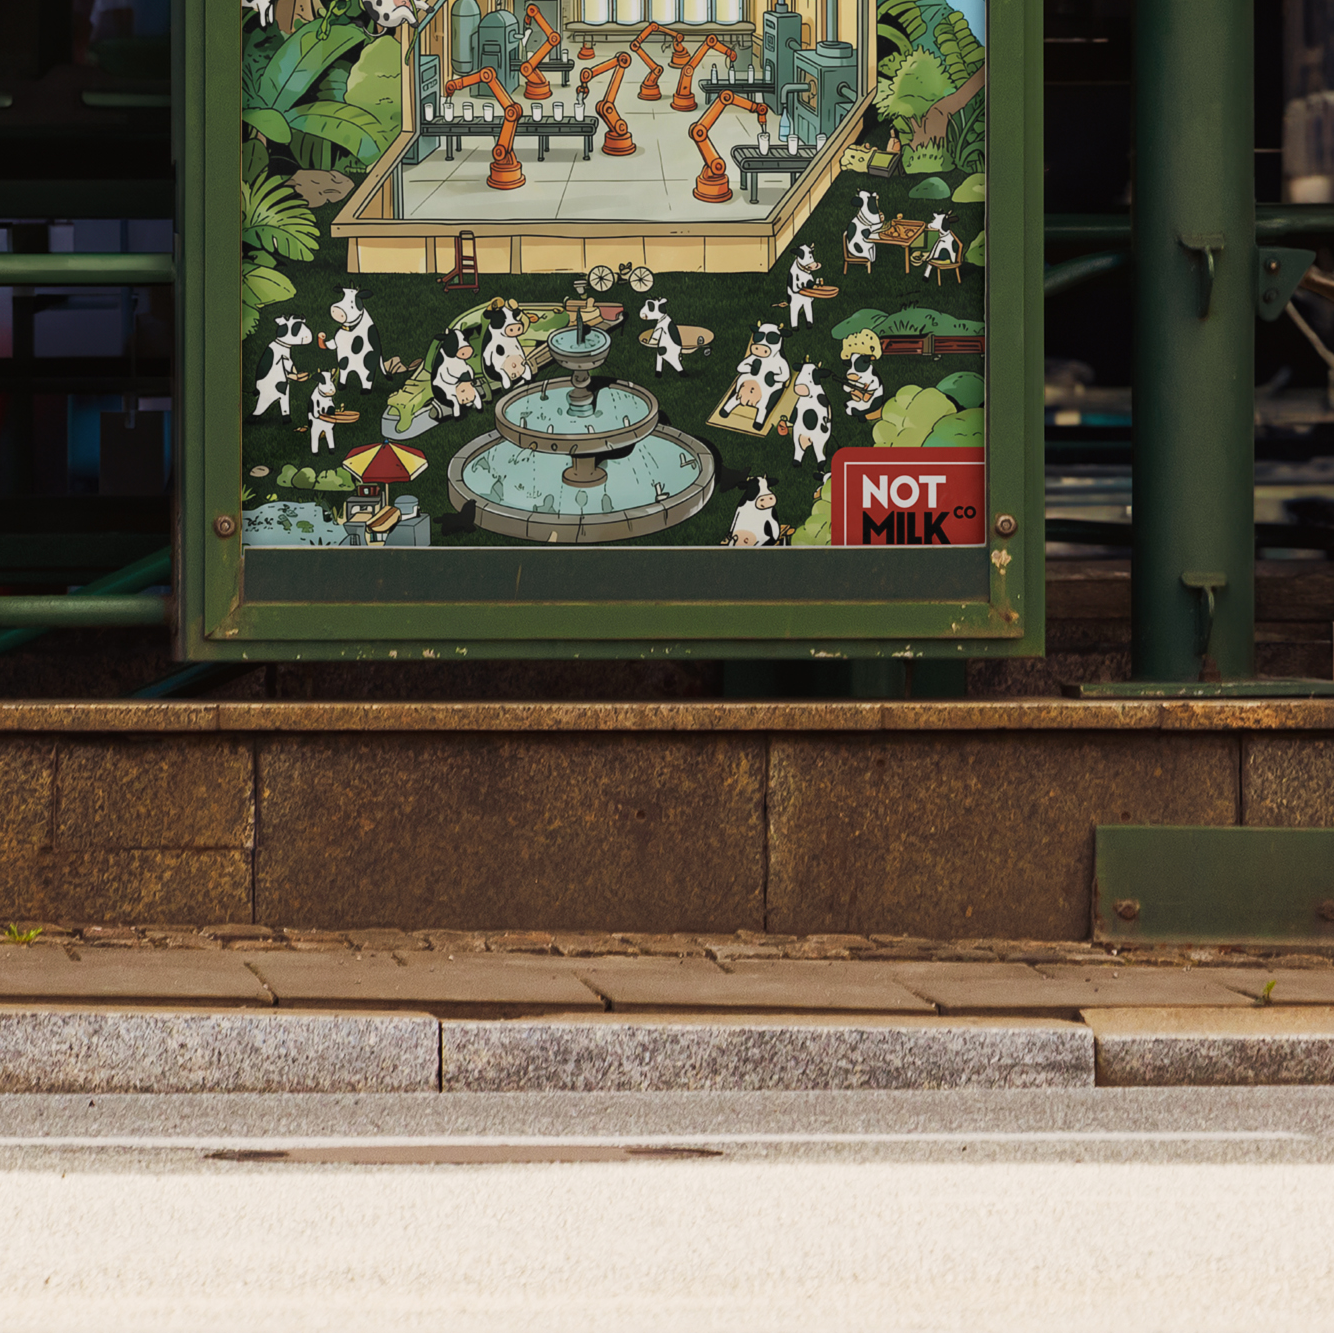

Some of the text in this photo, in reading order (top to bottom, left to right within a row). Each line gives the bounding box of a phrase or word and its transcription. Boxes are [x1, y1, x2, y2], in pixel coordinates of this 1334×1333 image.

[862, 474, 947, 509] NOT
[862, 505, 977, 545] MILK CO
